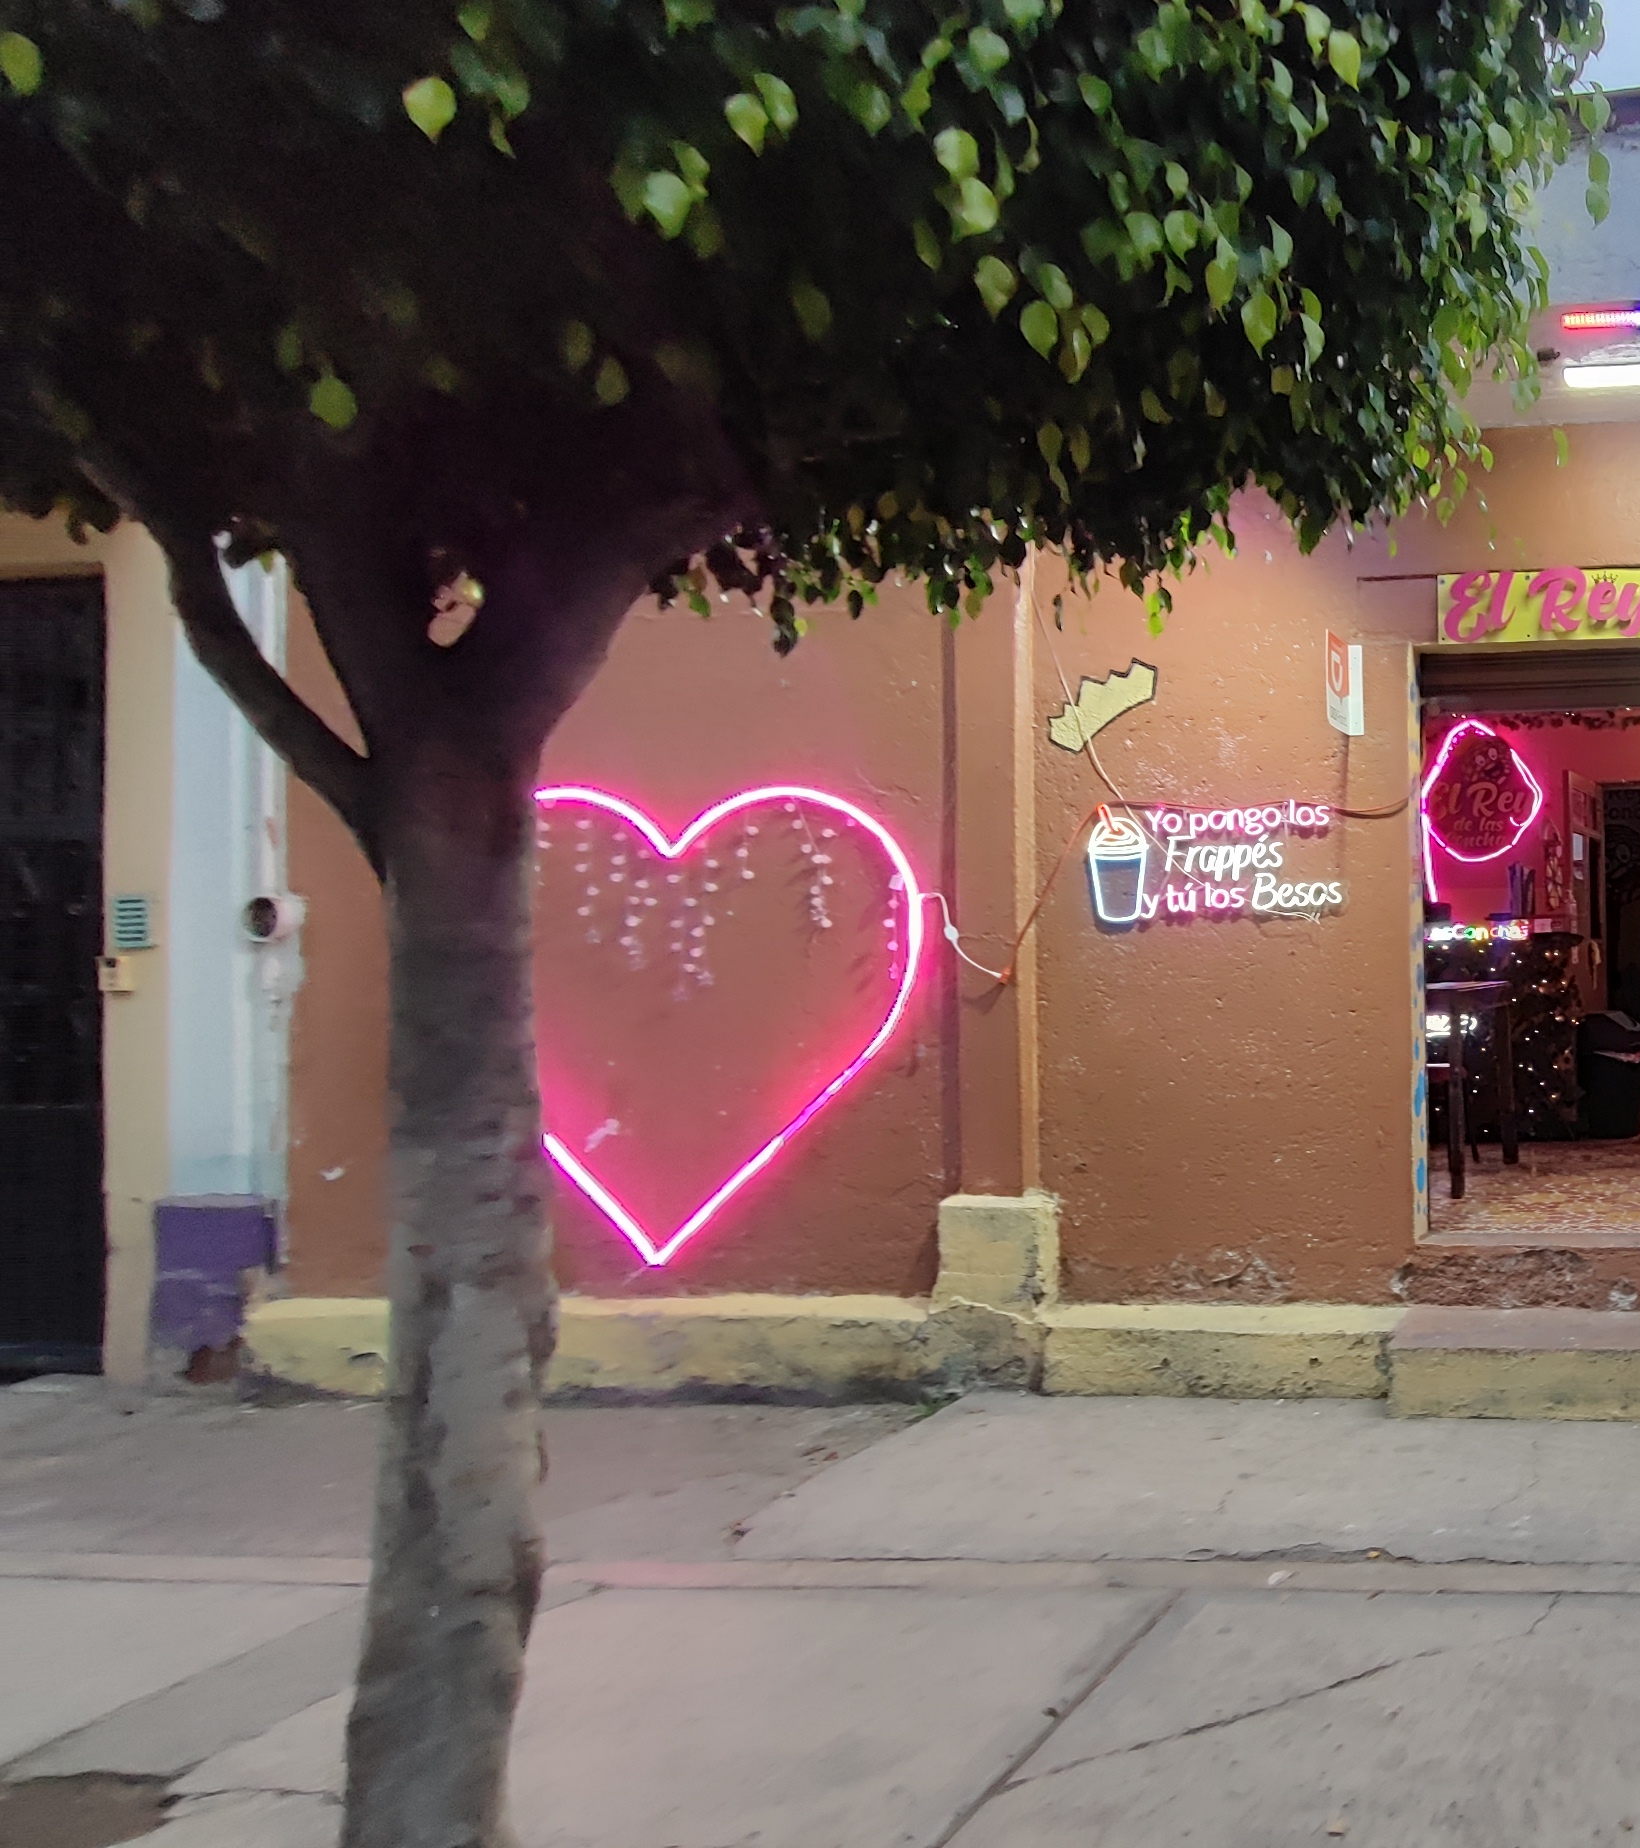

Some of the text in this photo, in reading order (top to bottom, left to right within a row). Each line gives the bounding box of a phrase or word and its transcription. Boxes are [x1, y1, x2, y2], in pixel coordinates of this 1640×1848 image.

[1444, 570, 1516, 643] El
[1145, 799, 1330, 840] Yo pongo los
[1165, 834, 1284, 882] Frappés
[1140, 872, 1343, 919] y tú los Besos
